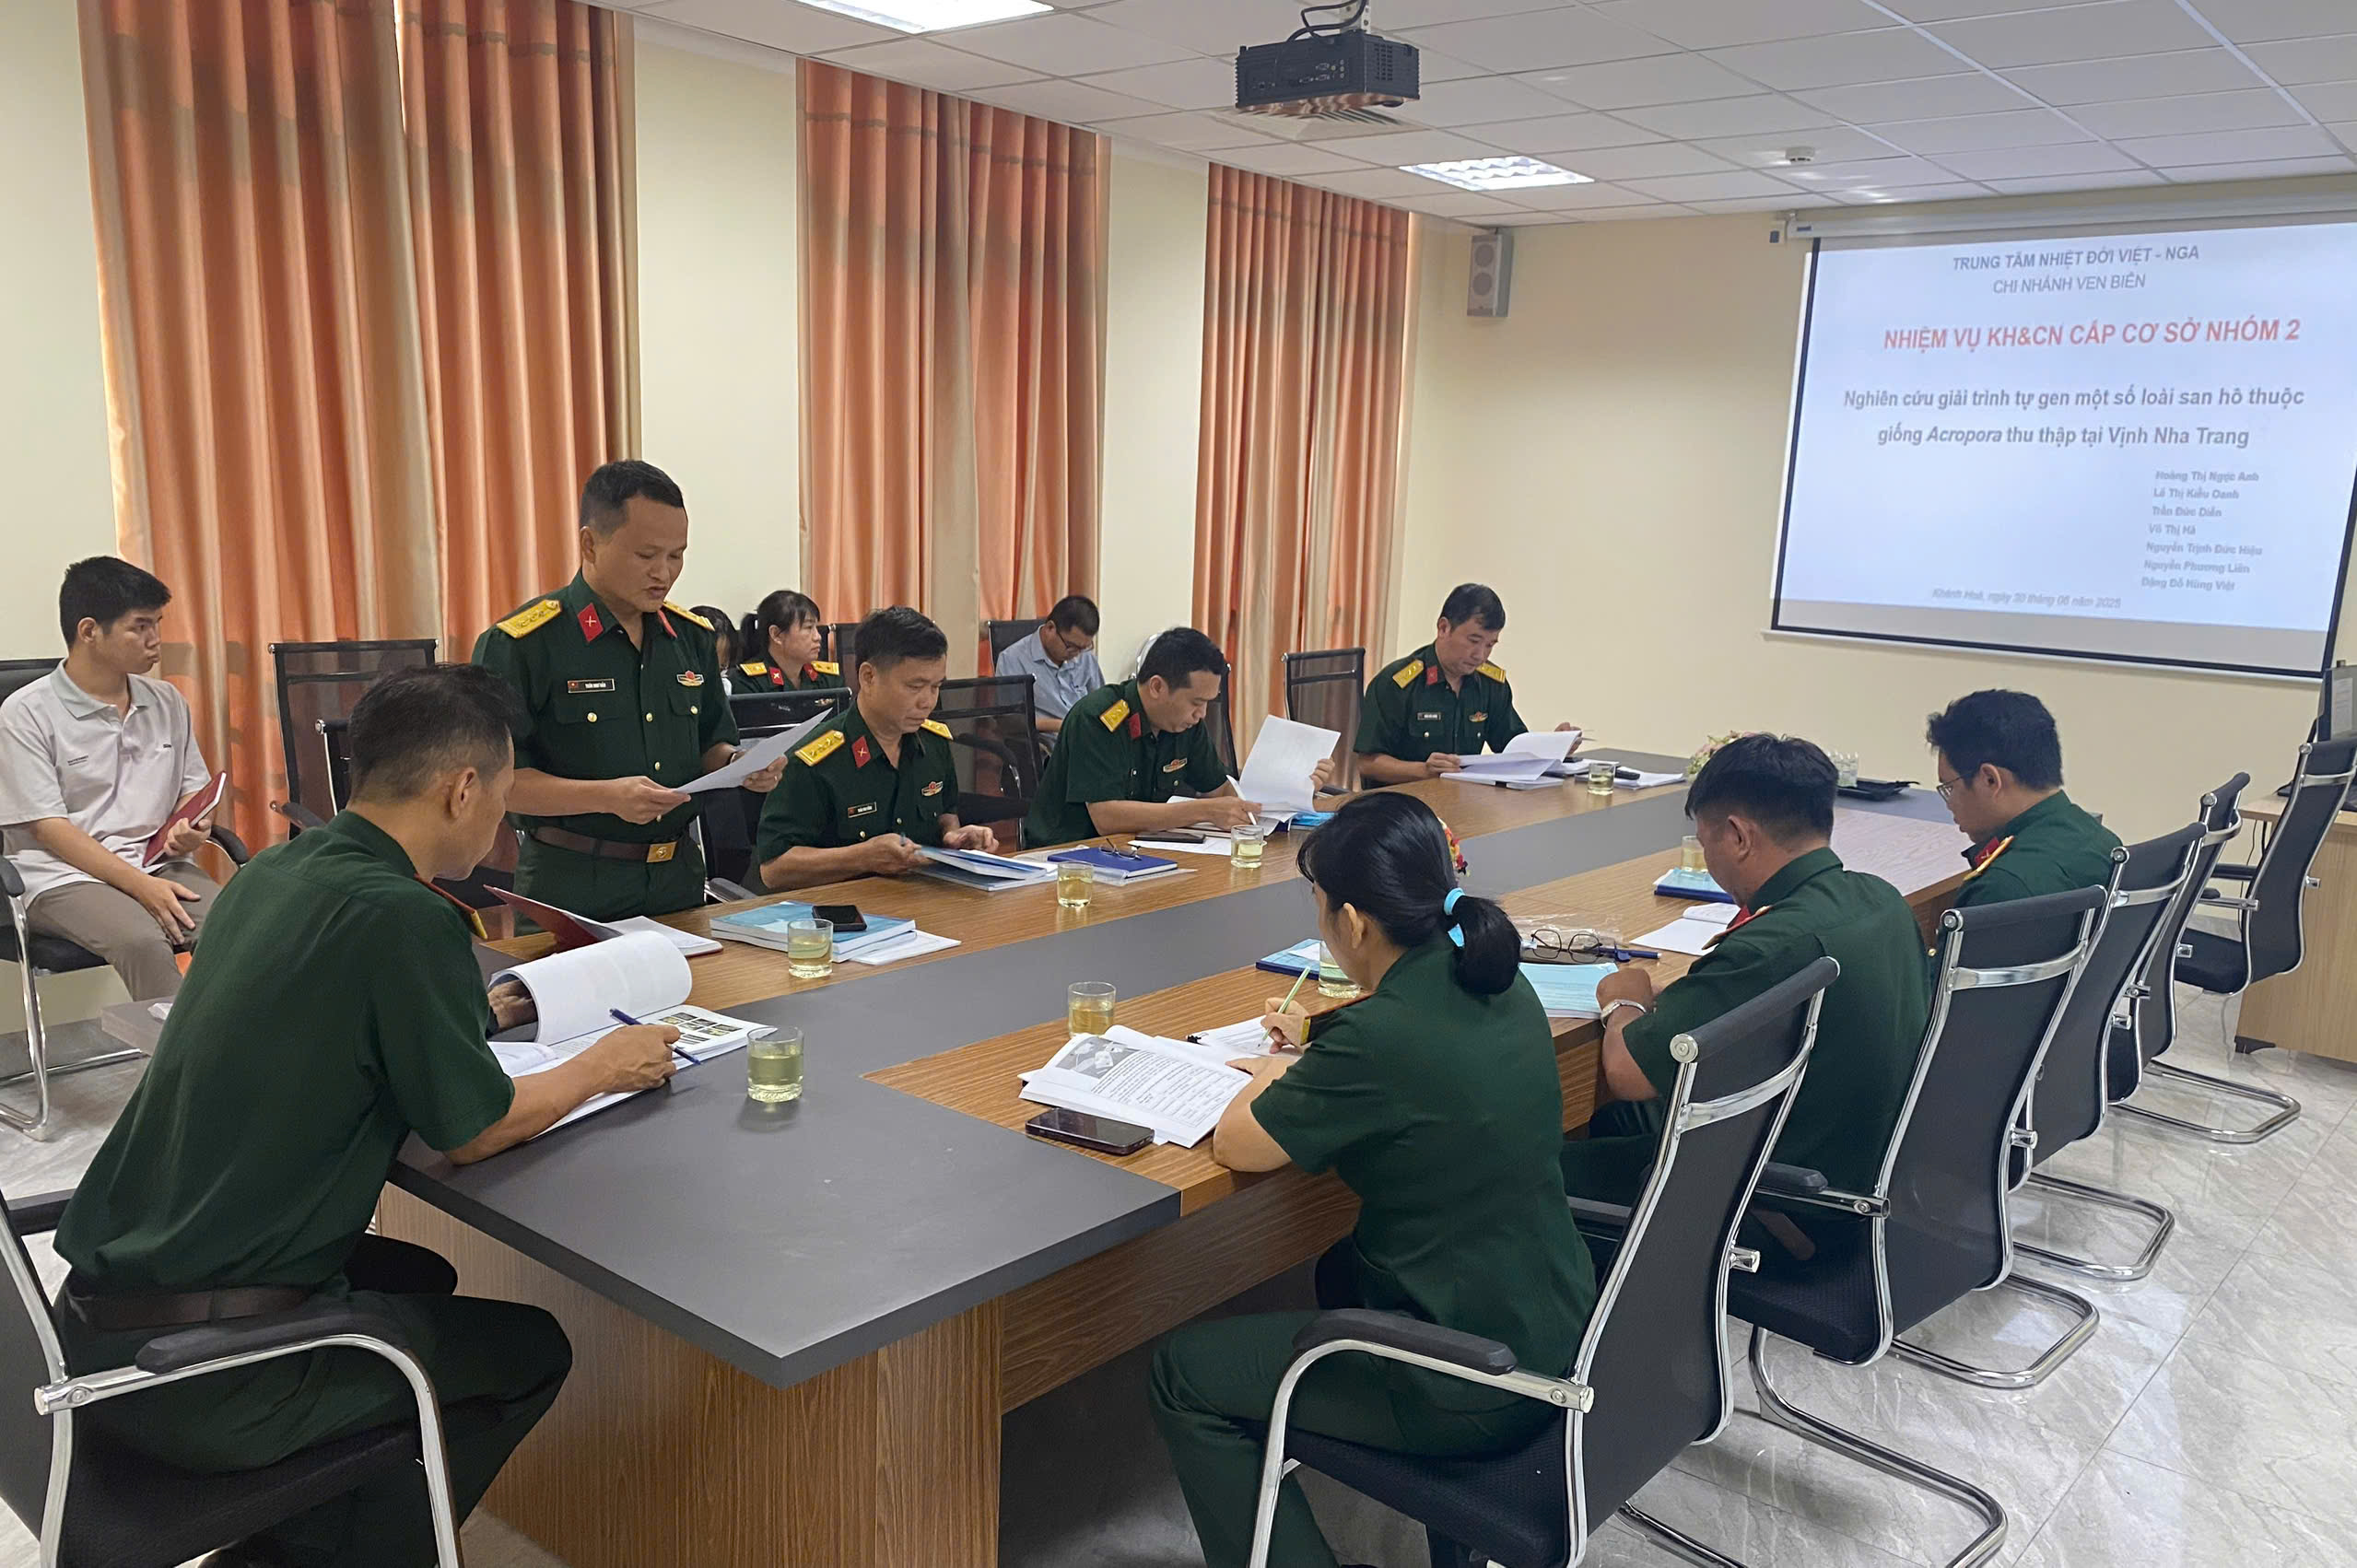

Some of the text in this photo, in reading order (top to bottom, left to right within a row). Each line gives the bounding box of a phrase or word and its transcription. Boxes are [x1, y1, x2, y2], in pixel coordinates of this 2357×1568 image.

[1952, 255, 2000, 270] TRUNG
[2039, 250, 2082, 270] NHIỆT
[2118, 247, 2152, 265] VIỆT
[2165, 245, 2199, 260] NGA
[1993, 279, 2018, 294] CHI
[2021, 275, 2072, 293] NHÁNH
[2076, 275, 2107, 290] VEN
[1883, 326, 1947, 354] NHIỆM
[1954, 327, 1981, 353] VỤ
[1987, 325, 2063, 347] KH&CN
[2122, 322, 2159, 344] CƠ
[2164, 316, 2200, 343] SỞ
[2206, 314, 2280, 343] NHÓM
[2285, 319, 2301, 340] 2
[1844, 384, 2304, 410] Nghiên cứu giải trình tự gen một số loài san hô thuộc
[1878, 422, 2249, 449] giống Acropora thu thập tại Vịnh Nha Trang
